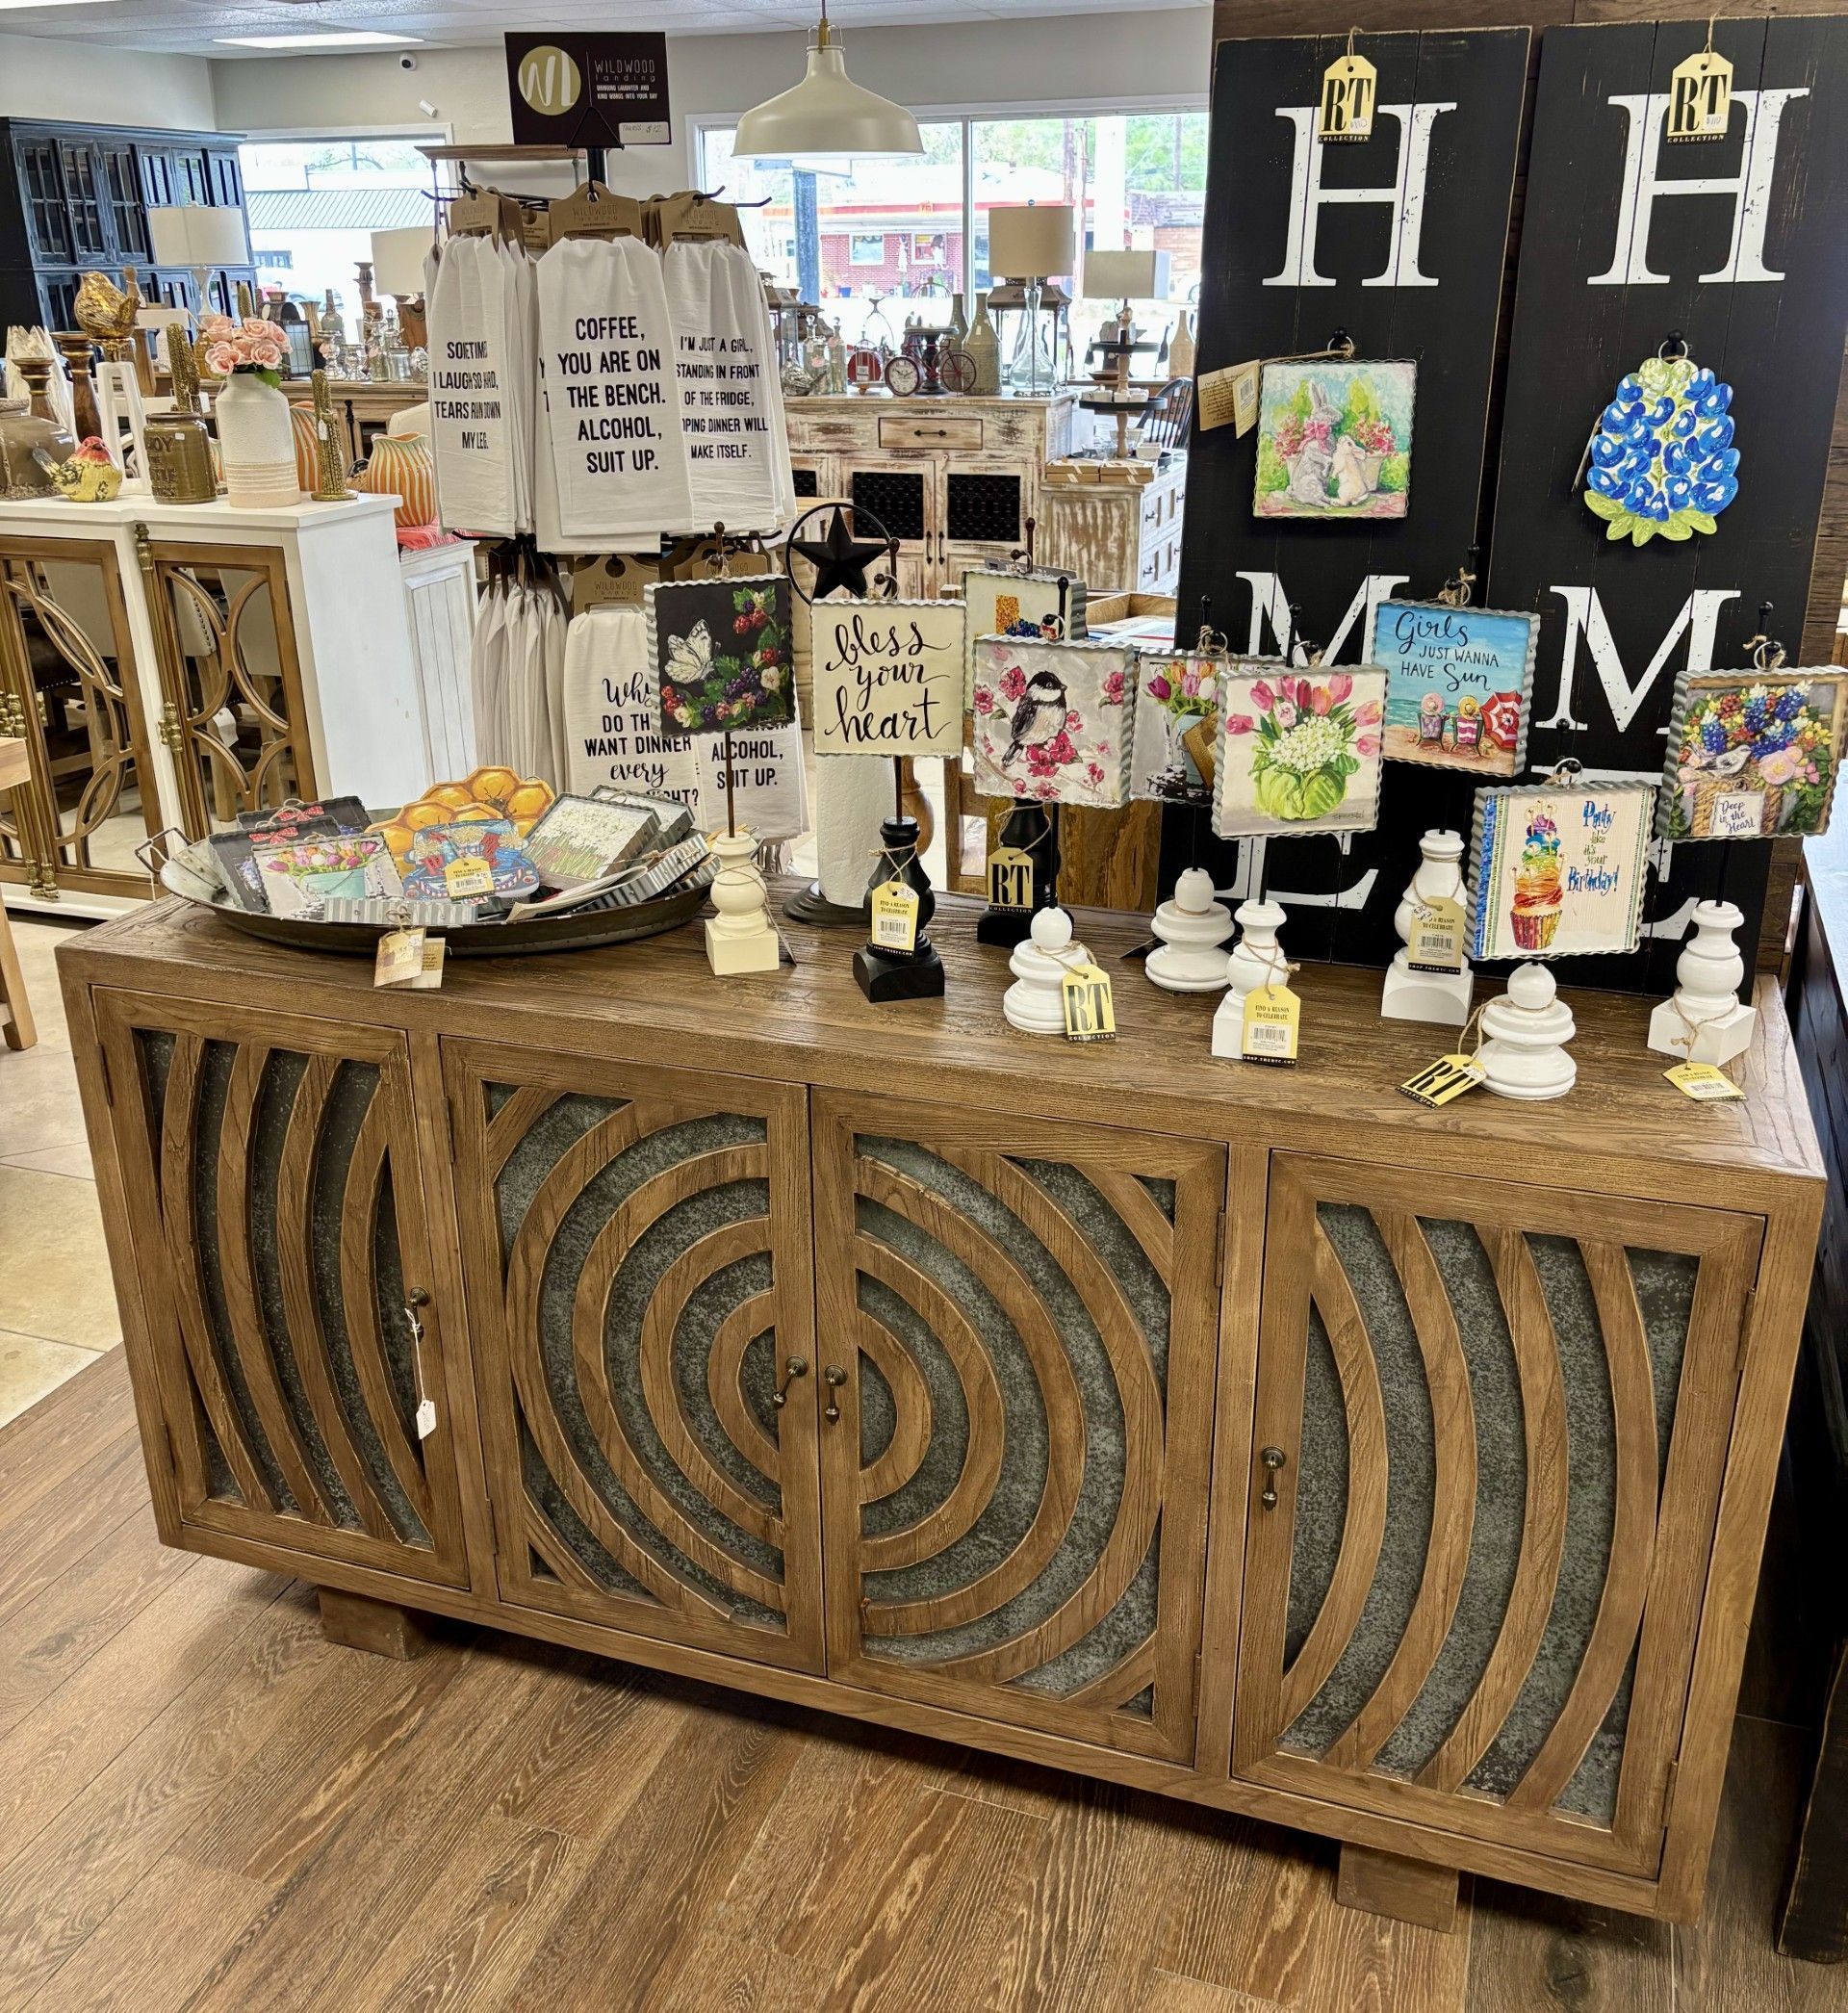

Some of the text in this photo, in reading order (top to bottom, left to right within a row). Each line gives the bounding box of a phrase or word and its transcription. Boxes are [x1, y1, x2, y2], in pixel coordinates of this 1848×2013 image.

[594, 59, 655, 74] WILDWOOD
[1321, 78, 1372, 132] RT
[1670, 74, 1728, 133] RT
[1667, 134, 1725, 143] COLLECTION
[1262, 102, 1457, 287] H
[1587, 88, 1810, 286] H
[573, 204, 617, 217] WILDWOOD
[576, 317, 645, 341] COFFEE,
[680, 336, 753, 353] I'M JUST A GIRL,
[557, 352, 592, 374] YOU
[600, 350, 631, 374] ARE
[637, 349, 660, 371] ON
[716, 365, 726, 378] IN
[730, 364, 759, 379] FRONT
[433, 372, 436, 388] I
[473, 372, 482, 389] SO
[567, 386, 600, 407] THE
[605, 382, 665, 406] BENCH.
[684, 391, 755, 406] OF THE FRIDGE,
[435, 401, 469, 419] TEARS
[578, 416, 662, 441] ALCOHOL,
[708, 418, 740, 432] DINNER
[744, 418, 768, 431] WILL
[462, 432, 489, 449] MY LEG.
[587, 450, 658, 473] SUIT UP.
[691, 445, 752, 458] MAKE ITSELF.
[594, 581, 637, 590] WILDWOOD
[825, 614, 952, 671] bless
[1396, 610, 1468, 654] Girls
[1420, 645, 1499, 667] JUST WANNA
[1535, 585, 1742, 735] M
[849, 662, 950, 711] your
[1401, 661, 1491, 691] HAVE Sun
[603, 713, 651, 733] DO TH
[824, 685, 952, 742] heart
[585, 736, 691, 757] WANT DINNER
[711, 740, 783, 761] ALCOHOL,
[610, 762, 670, 788] every
[756, 768, 778, 786] UP.
[1582, 801, 1617, 835] Party
[1718, 800, 1745, 815] Deep
[1719, 811, 1745, 824] in the
[1726, 816, 1756, 835] Heart
[1590, 830, 1605, 844] like
[1583, 844, 1596, 855] it's
[1584, 855, 1607, 866] your
[990, 863, 1030, 906] RT
[1567, 865, 1620, 896] Birthday!
[1065, 983, 1110, 1032] RT
[1404, 1060, 1476, 1099] RT
